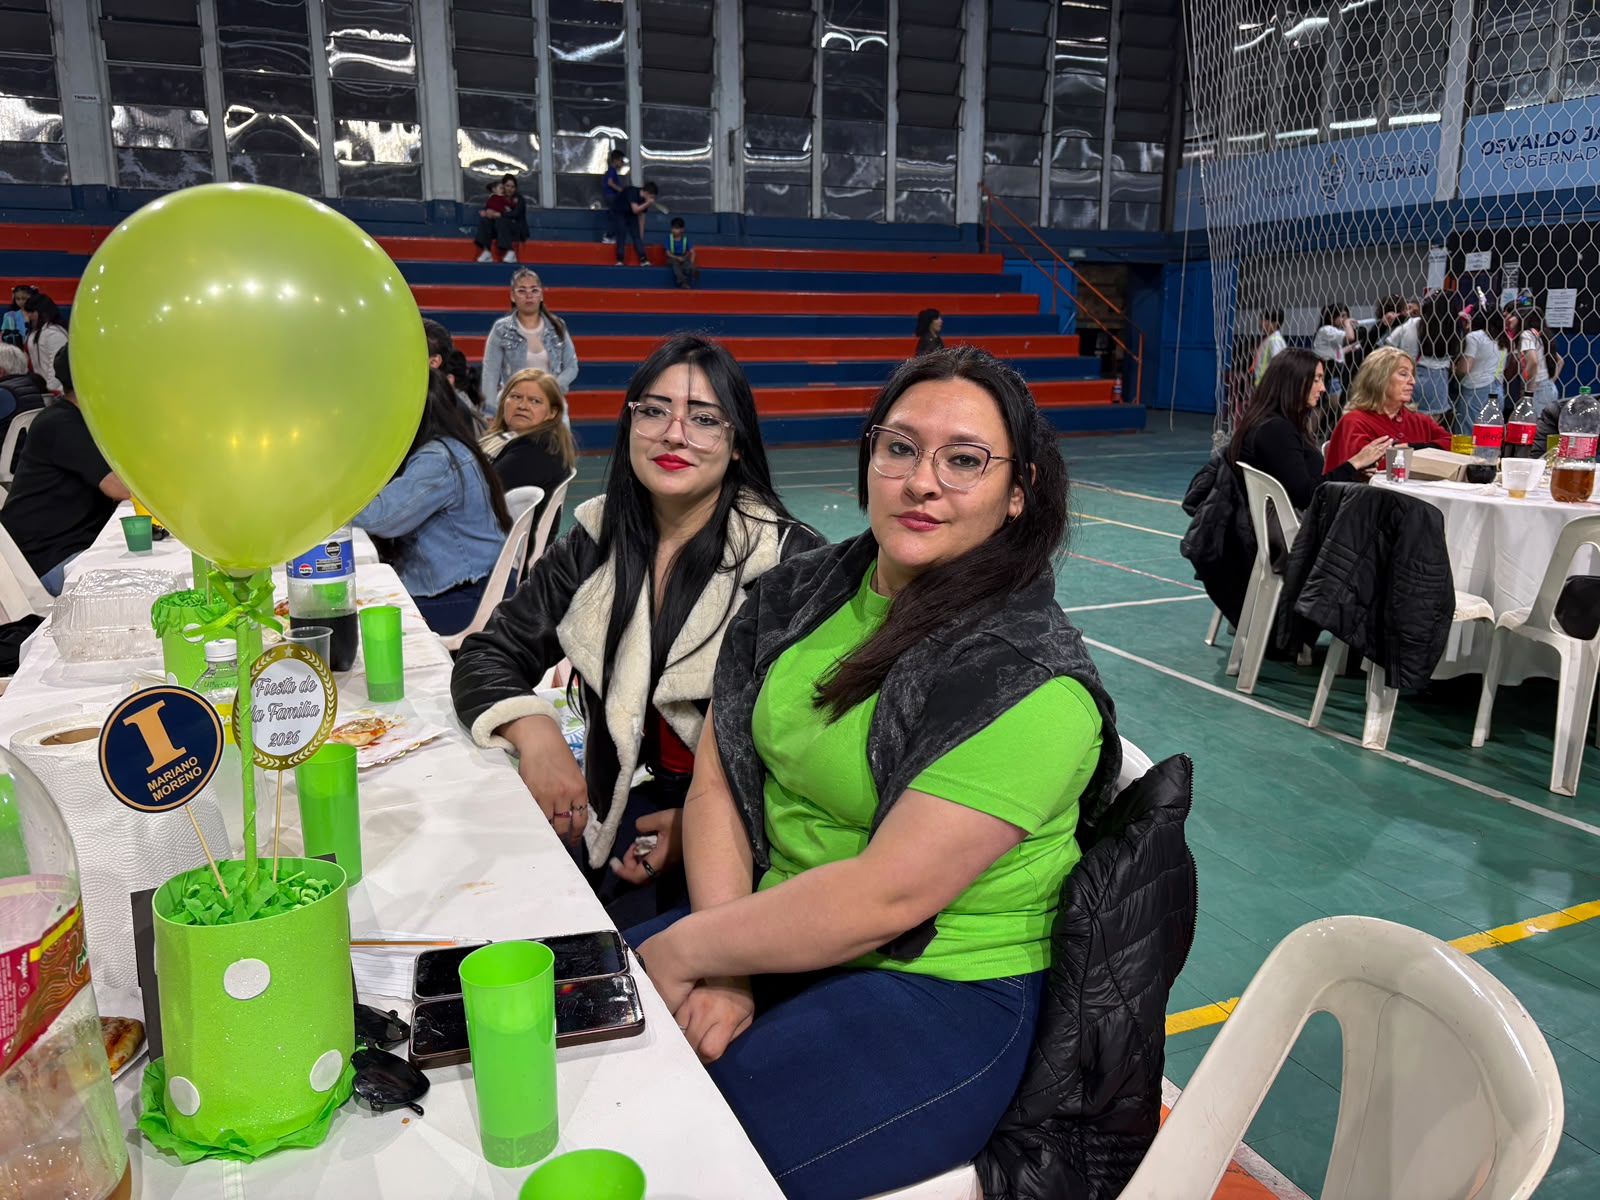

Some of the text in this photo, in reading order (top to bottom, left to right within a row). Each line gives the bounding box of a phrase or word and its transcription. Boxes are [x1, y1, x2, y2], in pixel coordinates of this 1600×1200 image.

[1481, 128, 1577, 156] OSVALDO
[1502, 146, 1600, 171] GOBERNAD
[1358, 161, 1430, 184] TUCUMÁN
[255, 675, 317, 697] Fiesta de
[251, 700, 320, 723] la Familia
[268, 730, 301, 747] 2026
[147, 757, 198, 791] MARIANO
[152, 767, 202, 801] MORENO
